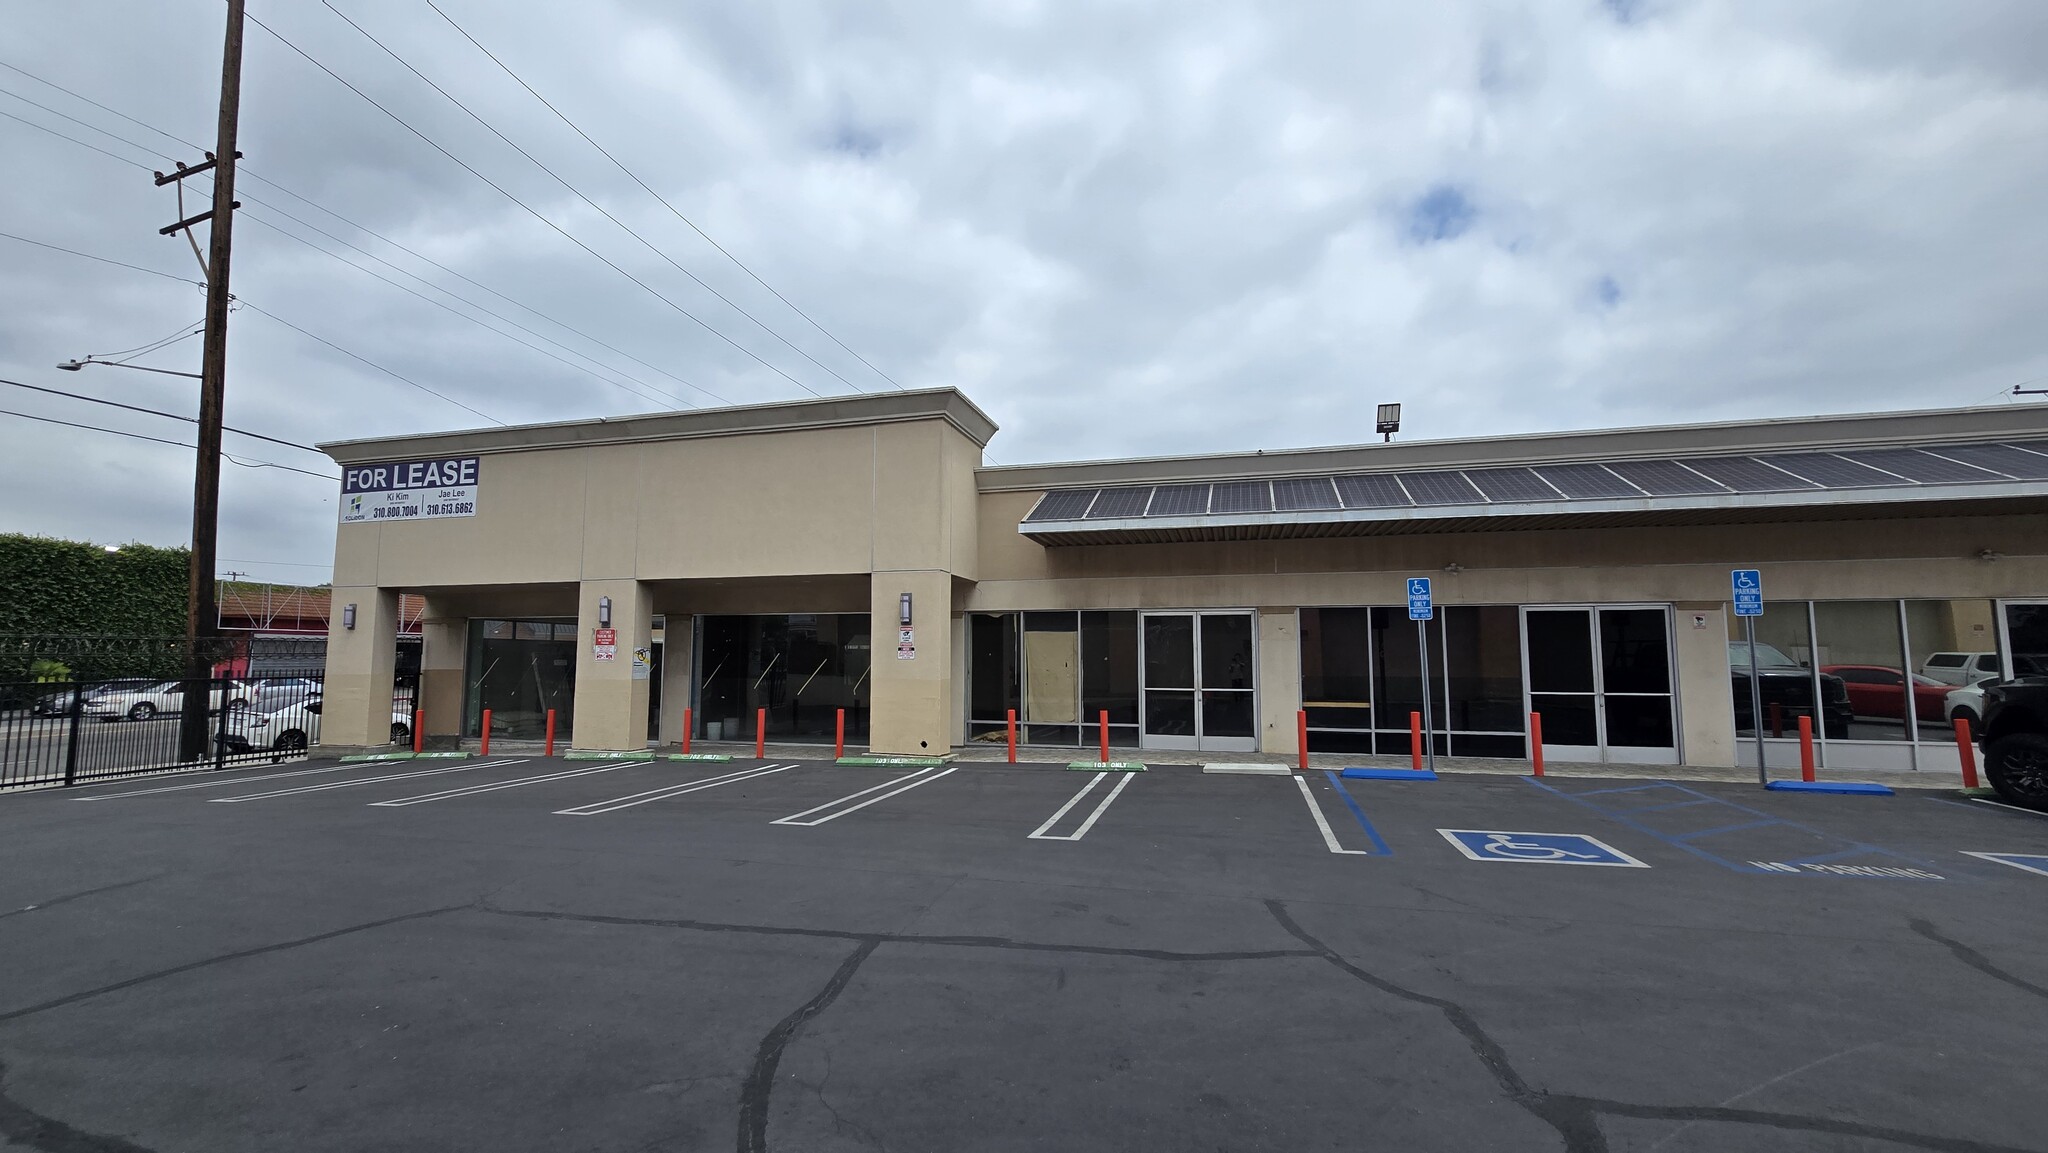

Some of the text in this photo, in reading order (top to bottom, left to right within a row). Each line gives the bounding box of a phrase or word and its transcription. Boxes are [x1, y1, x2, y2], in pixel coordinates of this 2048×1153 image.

[346, 459, 476, 490] FOR LEASE
[395, 492, 409, 500] Kim
[438, 489, 466, 499] Jae Lee
[426, 502, 473, 516] 310.613.6862
[1746, 860, 1945, 880] NO PARKING
